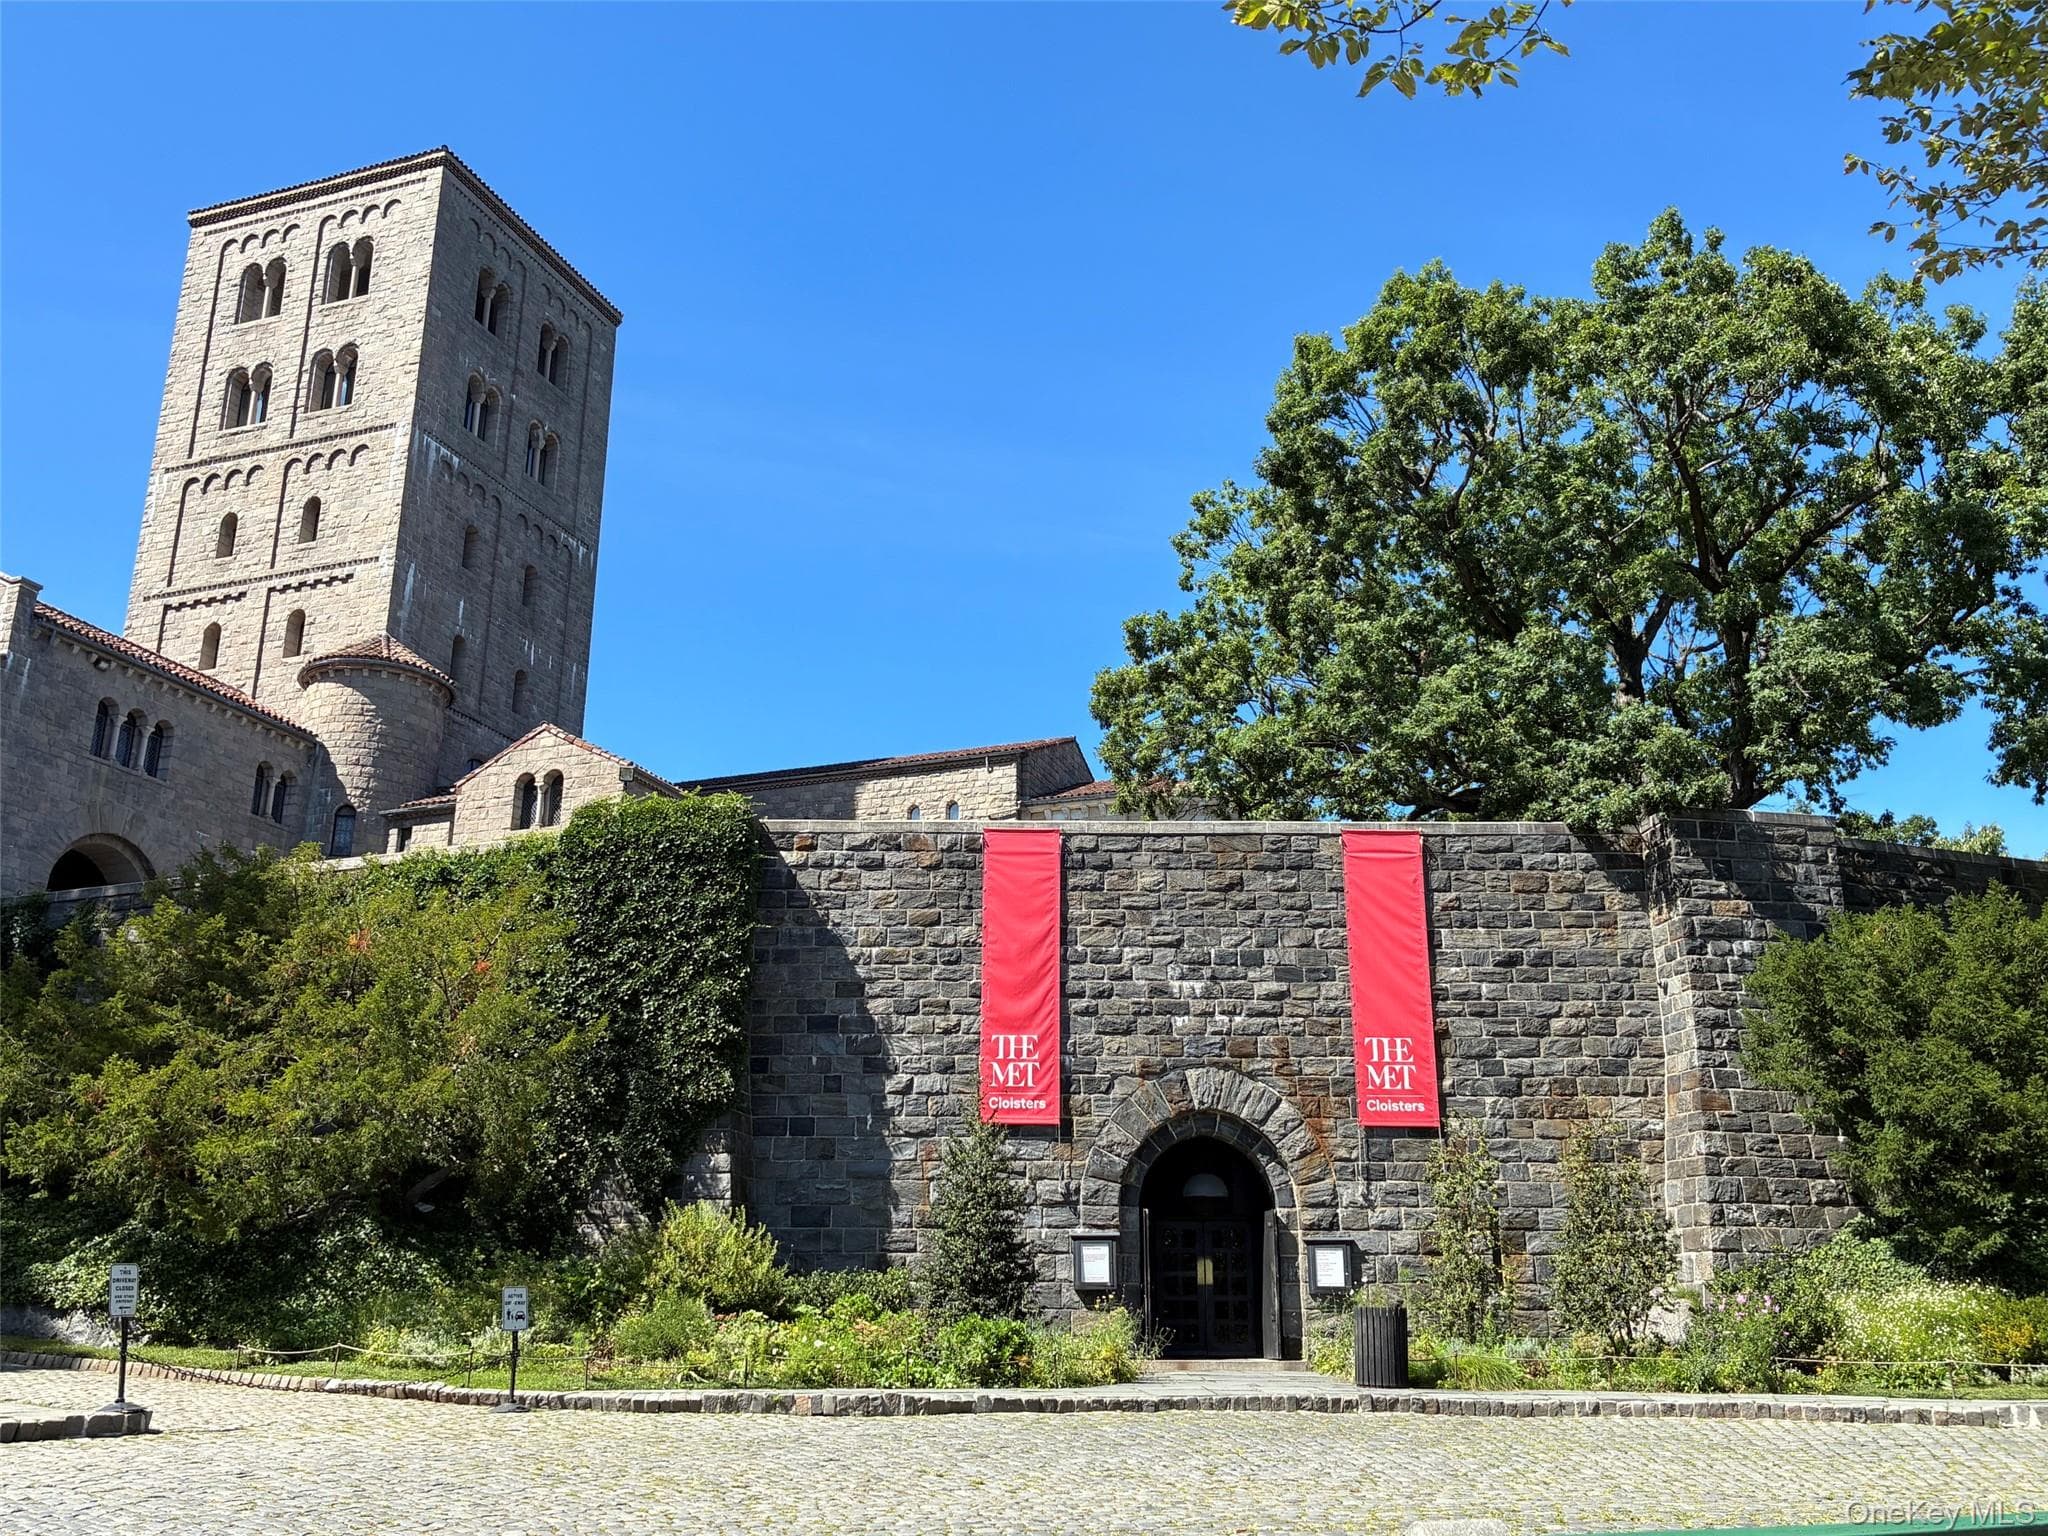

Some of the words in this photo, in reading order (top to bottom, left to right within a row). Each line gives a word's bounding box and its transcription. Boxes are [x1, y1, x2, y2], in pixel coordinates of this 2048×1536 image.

[991, 1034, 1040, 1060] THE
[1364, 1037, 1414, 1063] THE
[989, 1061, 1041, 1087] MET
[1365, 1064, 1416, 1090] MET
[988, 1097, 1047, 1109] Cloisters
[1366, 1099, 1425, 1112] Cloisters
